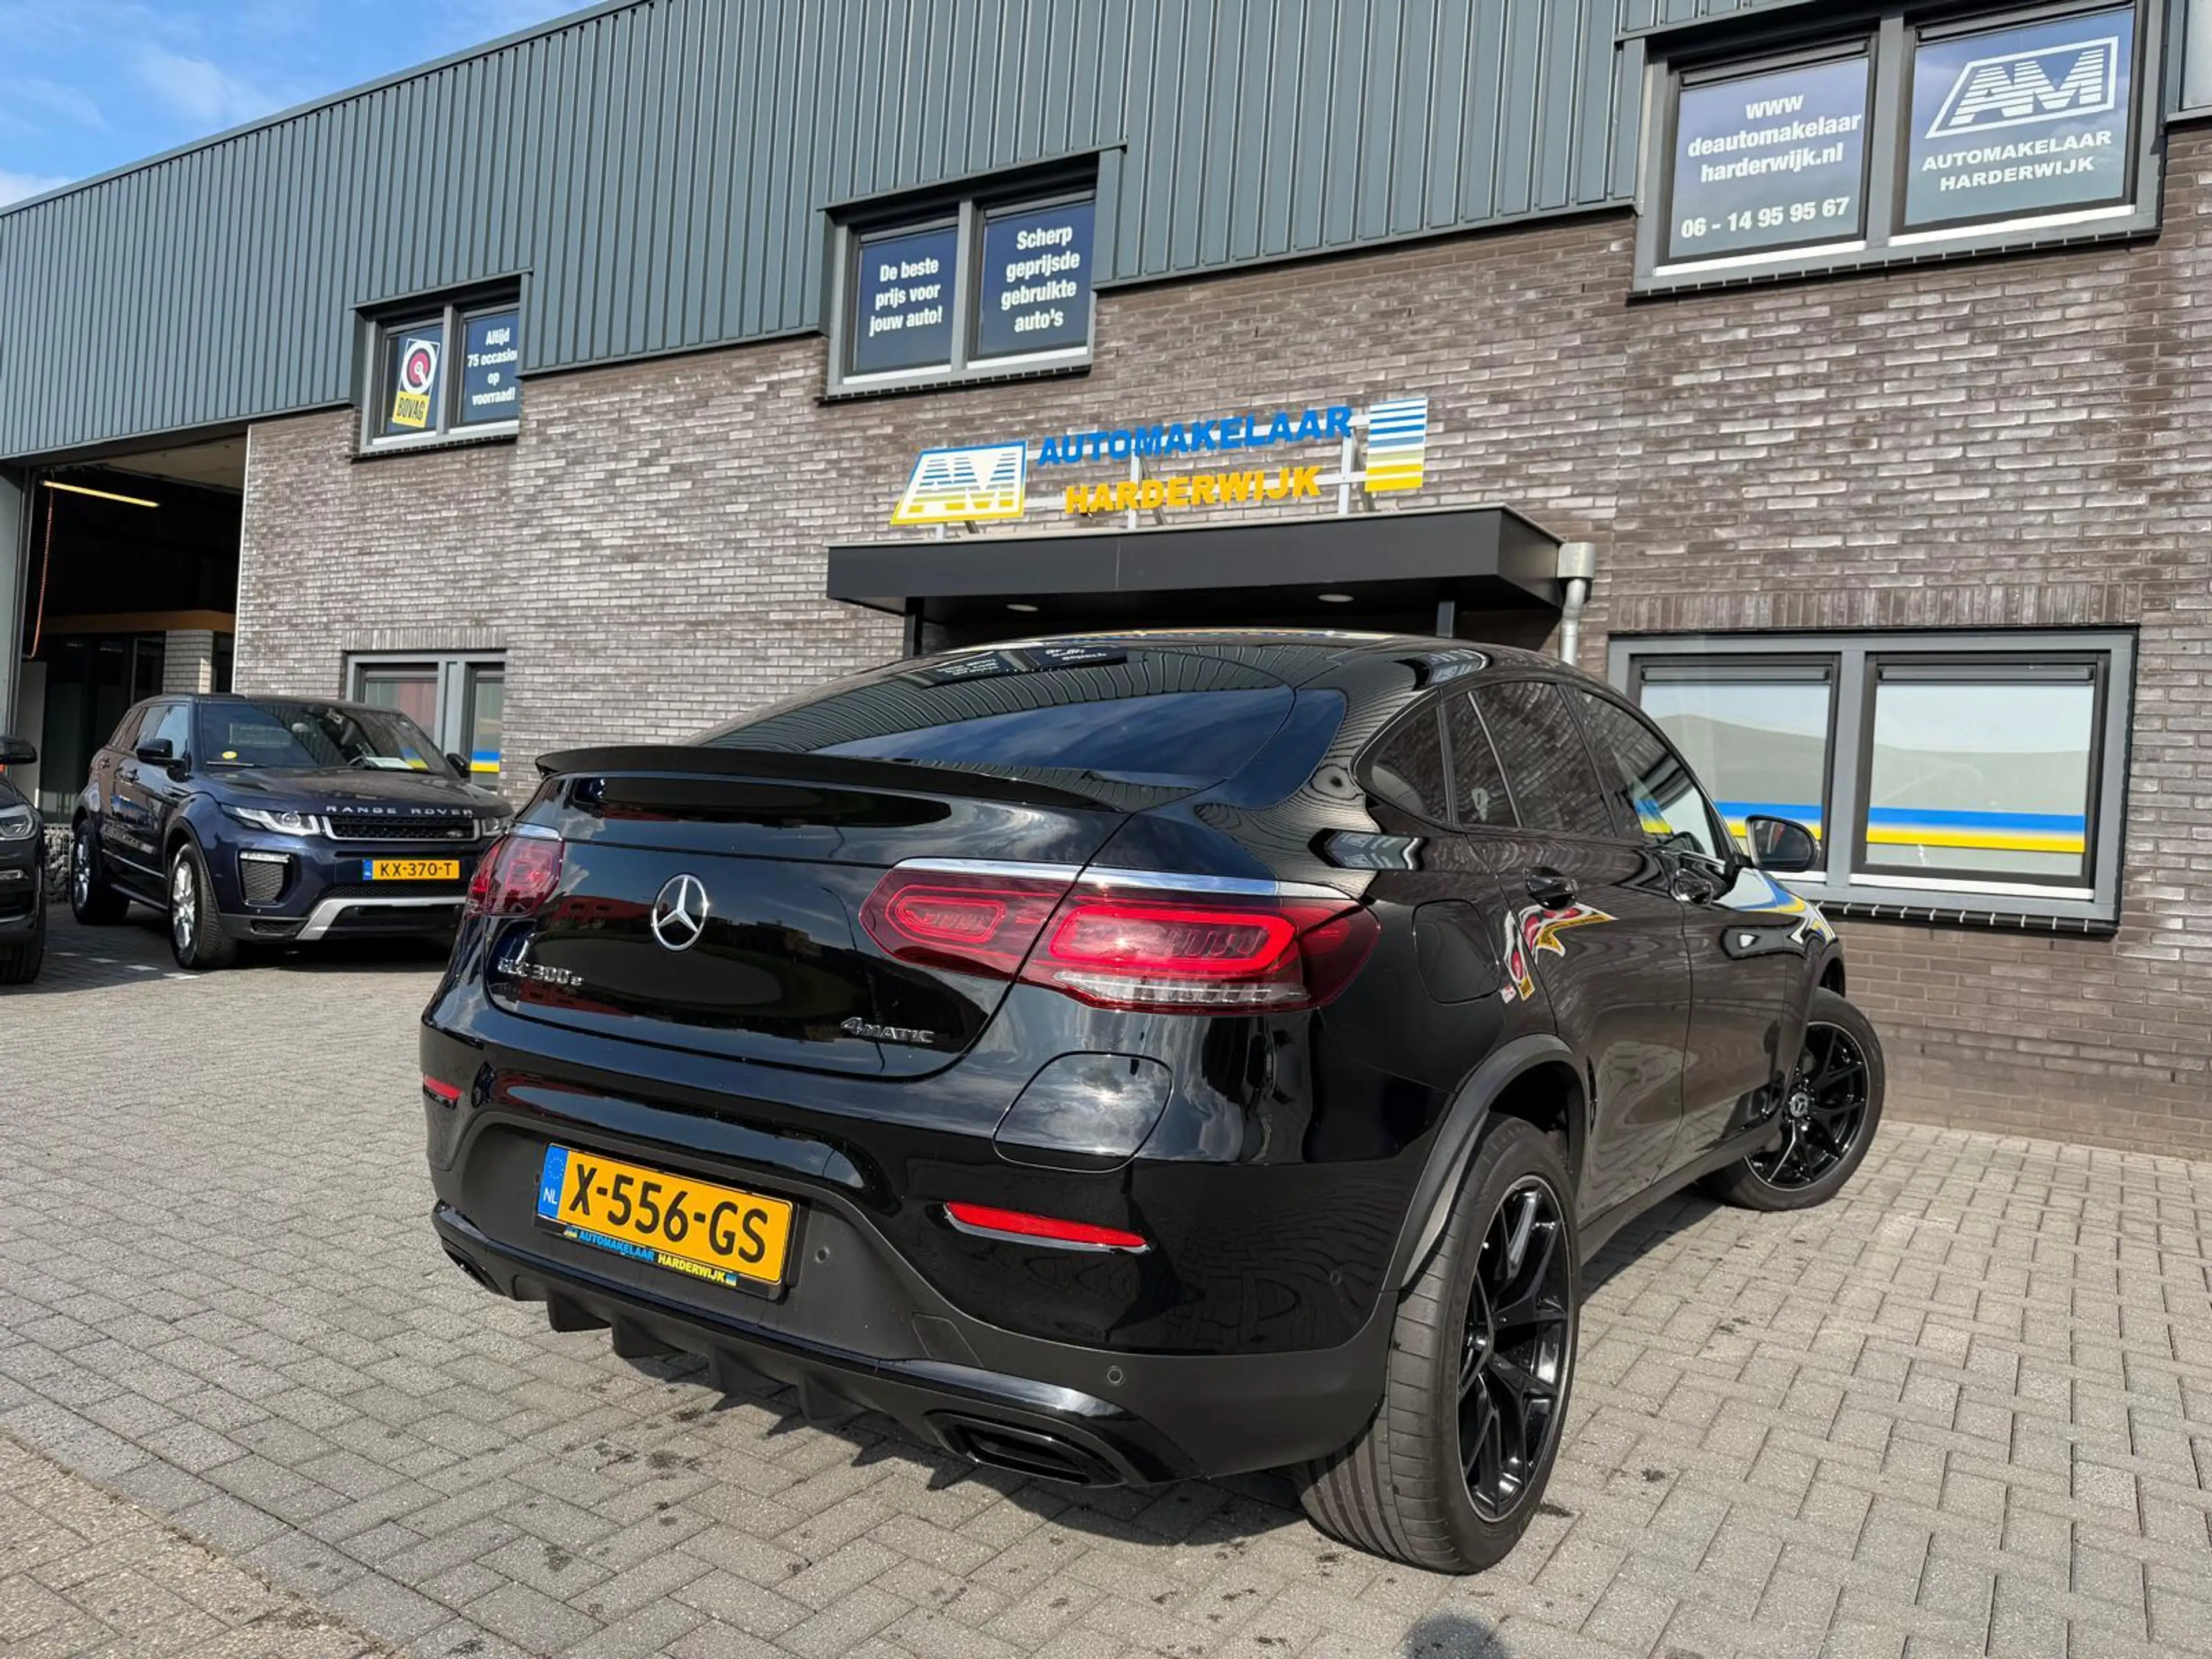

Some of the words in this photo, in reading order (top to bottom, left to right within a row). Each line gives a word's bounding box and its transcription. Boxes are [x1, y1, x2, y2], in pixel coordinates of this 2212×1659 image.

[1745, 95, 1804, 120] www
[1687, 114, 1862, 157] deautomakelaar
[1700, 142, 1844, 183] harderwijk.nl
[1921, 130, 2112, 172] AUTOMAKELAAR
[1940, 156, 2095, 191] HARDERWIJK
[1681, 217, 1707, 238] 06
[1728, 210, 1752, 231] 14
[1757, 206, 1783, 228] 95
[1790, 202, 1816, 222] 95
[1822, 196, 1850, 217] 67
[1017, 226, 1073, 250] Scherp
[880, 264, 898, 282] De
[901, 257, 939, 279] beste
[1006, 250, 1080, 282] geprijsde
[875, 287, 906, 310] prijs
[910, 284, 941, 302] voor
[1001, 279, 1077, 310] gebruikte
[869, 315, 904, 337] jouw
[906, 305, 942, 327] auto!
[1014, 308, 1064, 332] auto's
[485, 327, 510, 346] Altijd
[467, 354, 479, 368] 75
[488, 372, 500, 387] op
[472, 386, 516, 405] voorraad!
[396, 397, 425, 421] BOVAG
[1037, 406, 1352, 466] AUTOMAKELAAR
[1065, 465, 1321, 514] HARDERWIJK
[326, 806, 397, 814] RANGE
[411, 807, 474, 817] ROVER
[380, 863, 452, 876] KX-370-T
[543, 1187, 558, 1205] NL
[569, 1163, 768, 1263] X-556-GS
[578, 1230, 655, 1262] AUTOMAKELAAR
[658, 1253, 726, 1283] HARDERWIJK
